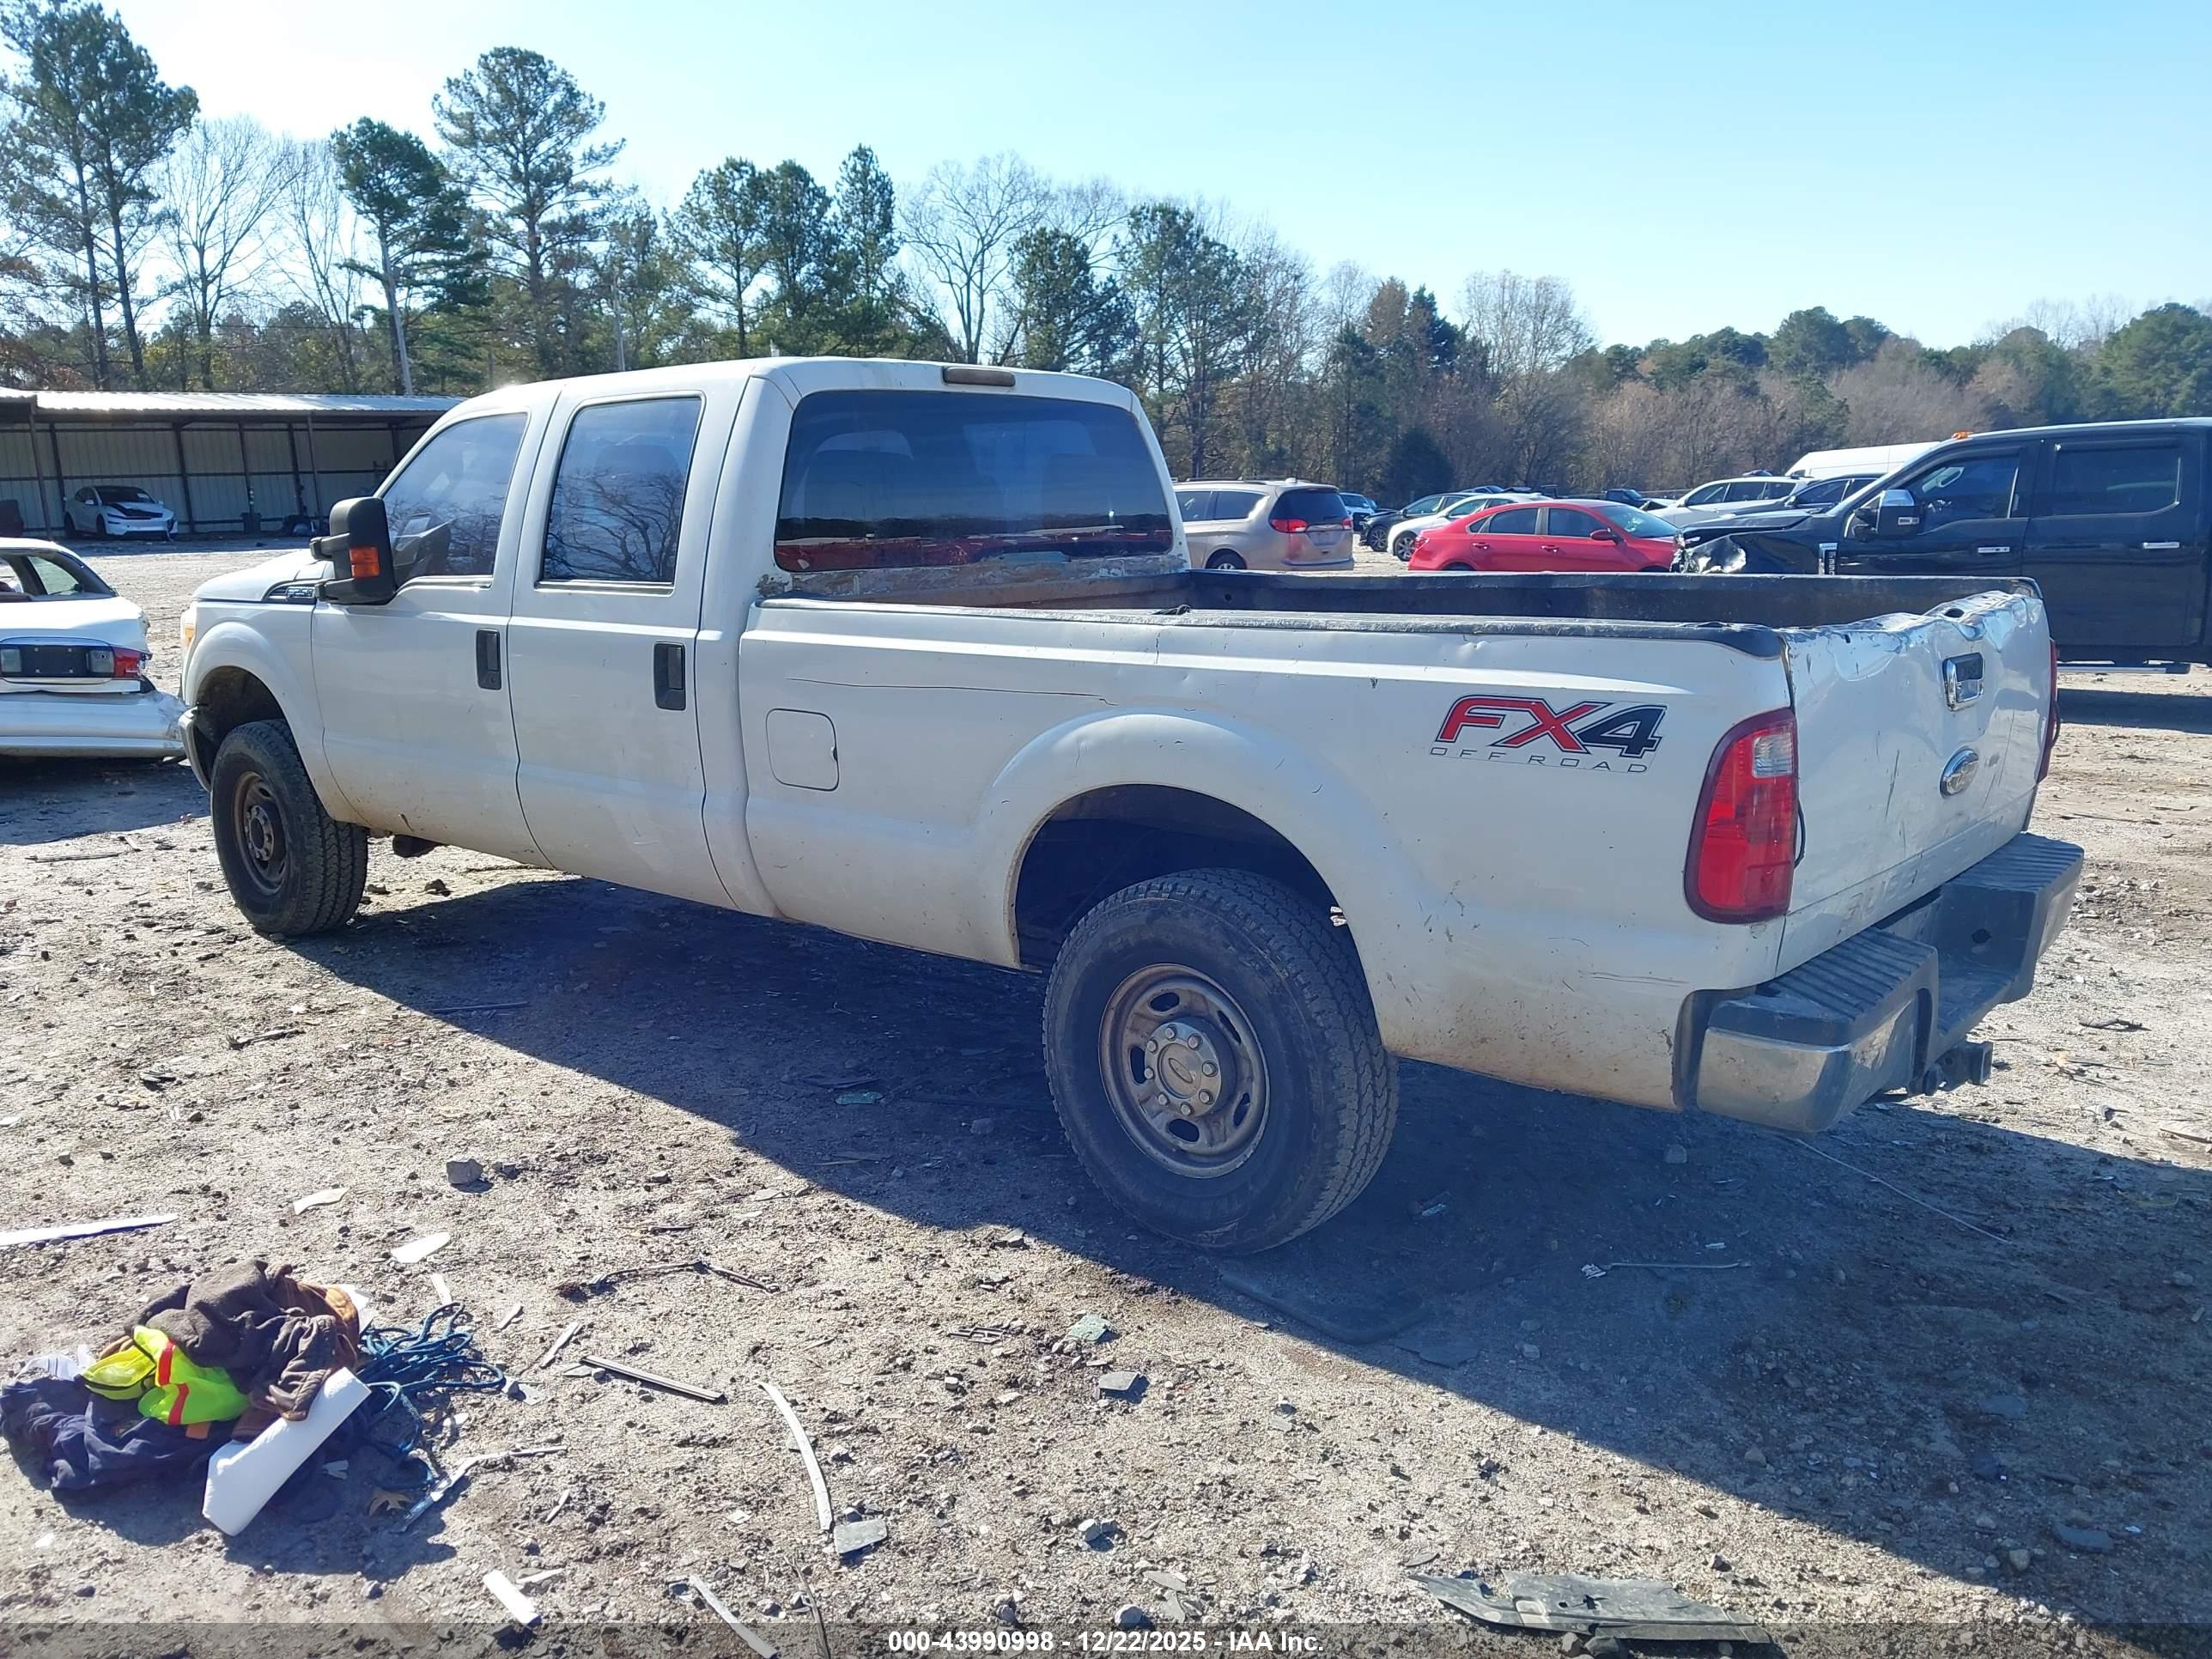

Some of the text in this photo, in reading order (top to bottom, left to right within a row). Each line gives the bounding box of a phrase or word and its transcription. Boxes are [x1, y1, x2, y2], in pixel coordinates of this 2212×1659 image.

[1435, 694, 1668, 759] FX4
[1430, 747, 1648, 773] OFF ROAD
